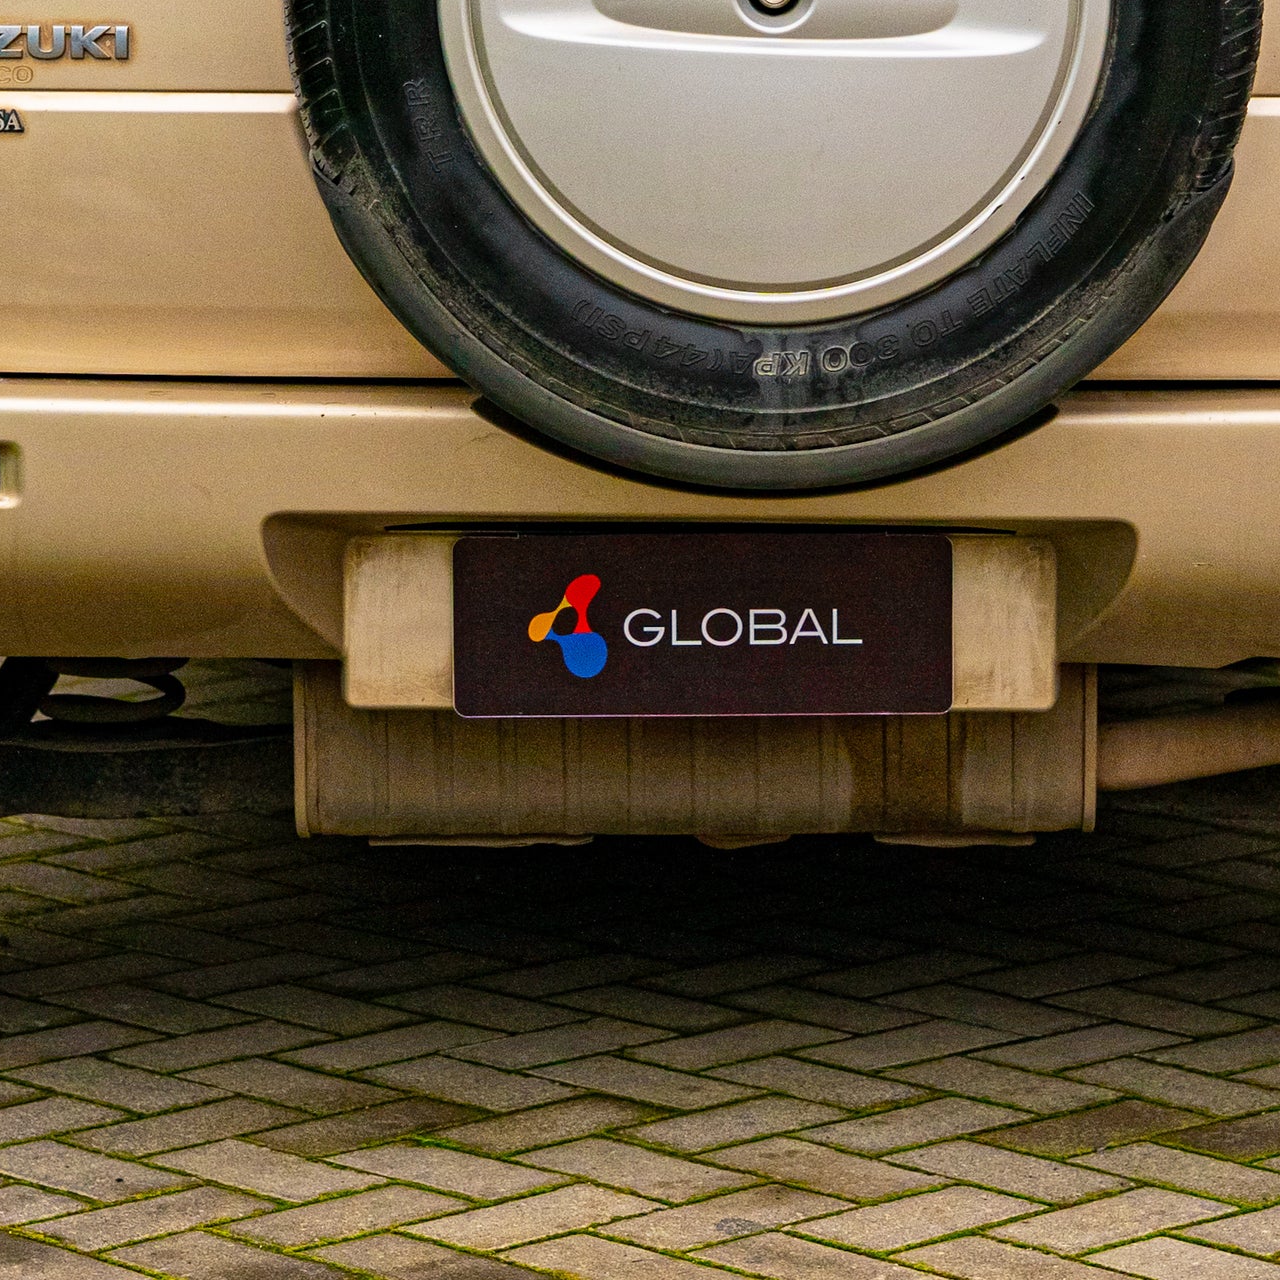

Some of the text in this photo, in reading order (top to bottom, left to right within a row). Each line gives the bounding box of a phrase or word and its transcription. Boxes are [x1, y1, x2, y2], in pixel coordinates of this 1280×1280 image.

[967, 191, 1095, 317] INFLATE
[910, 309, 964, 347] TO
[822, 334, 900, 372] 300
[623, 608, 863, 648] GLOBAL
